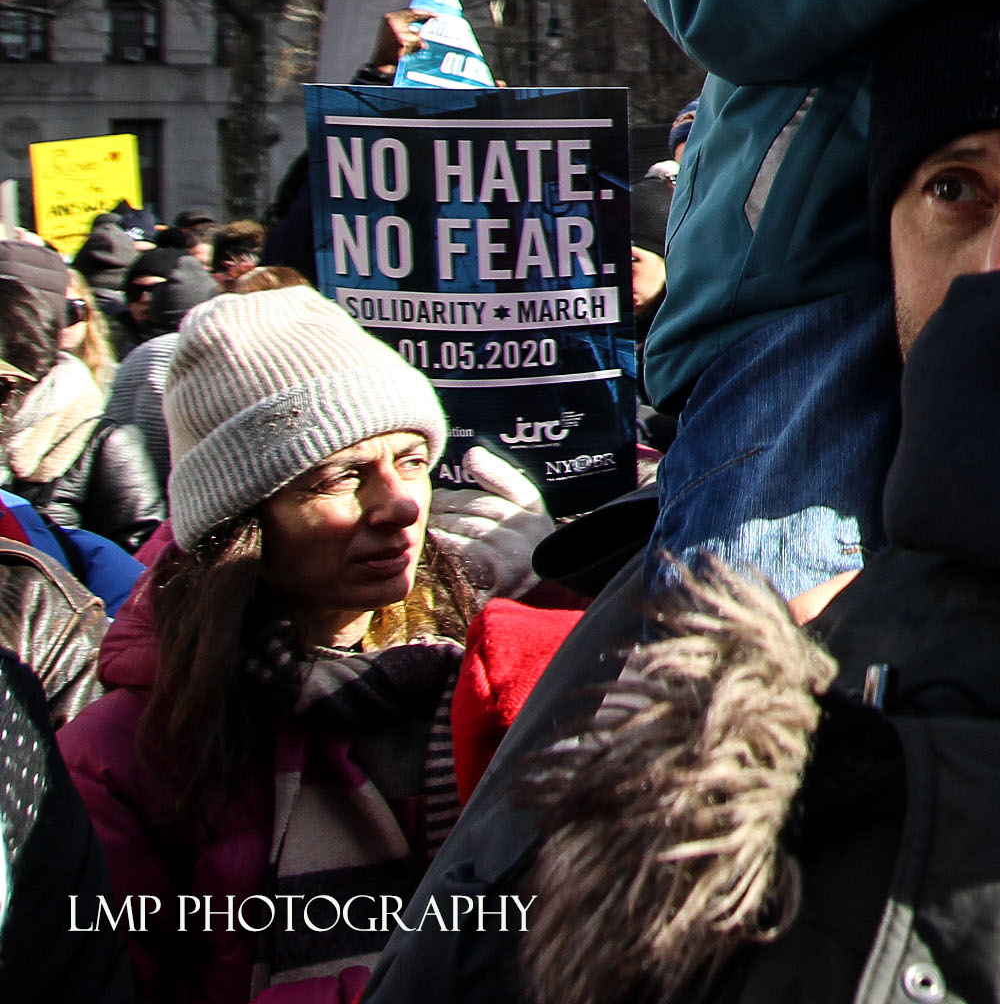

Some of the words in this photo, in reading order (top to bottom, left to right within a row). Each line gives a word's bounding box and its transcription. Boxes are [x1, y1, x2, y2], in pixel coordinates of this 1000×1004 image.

[326, 136, 410, 201] NO
[434, 139, 614, 202] HATE.
[331, 213, 413, 279] NO
[437, 216, 616, 280] FEAR.
[345, 295, 488, 326] SOLIDARITY
[516, 294, 607, 325] MARCH
[398, 338, 557, 370] 01.05.2020
